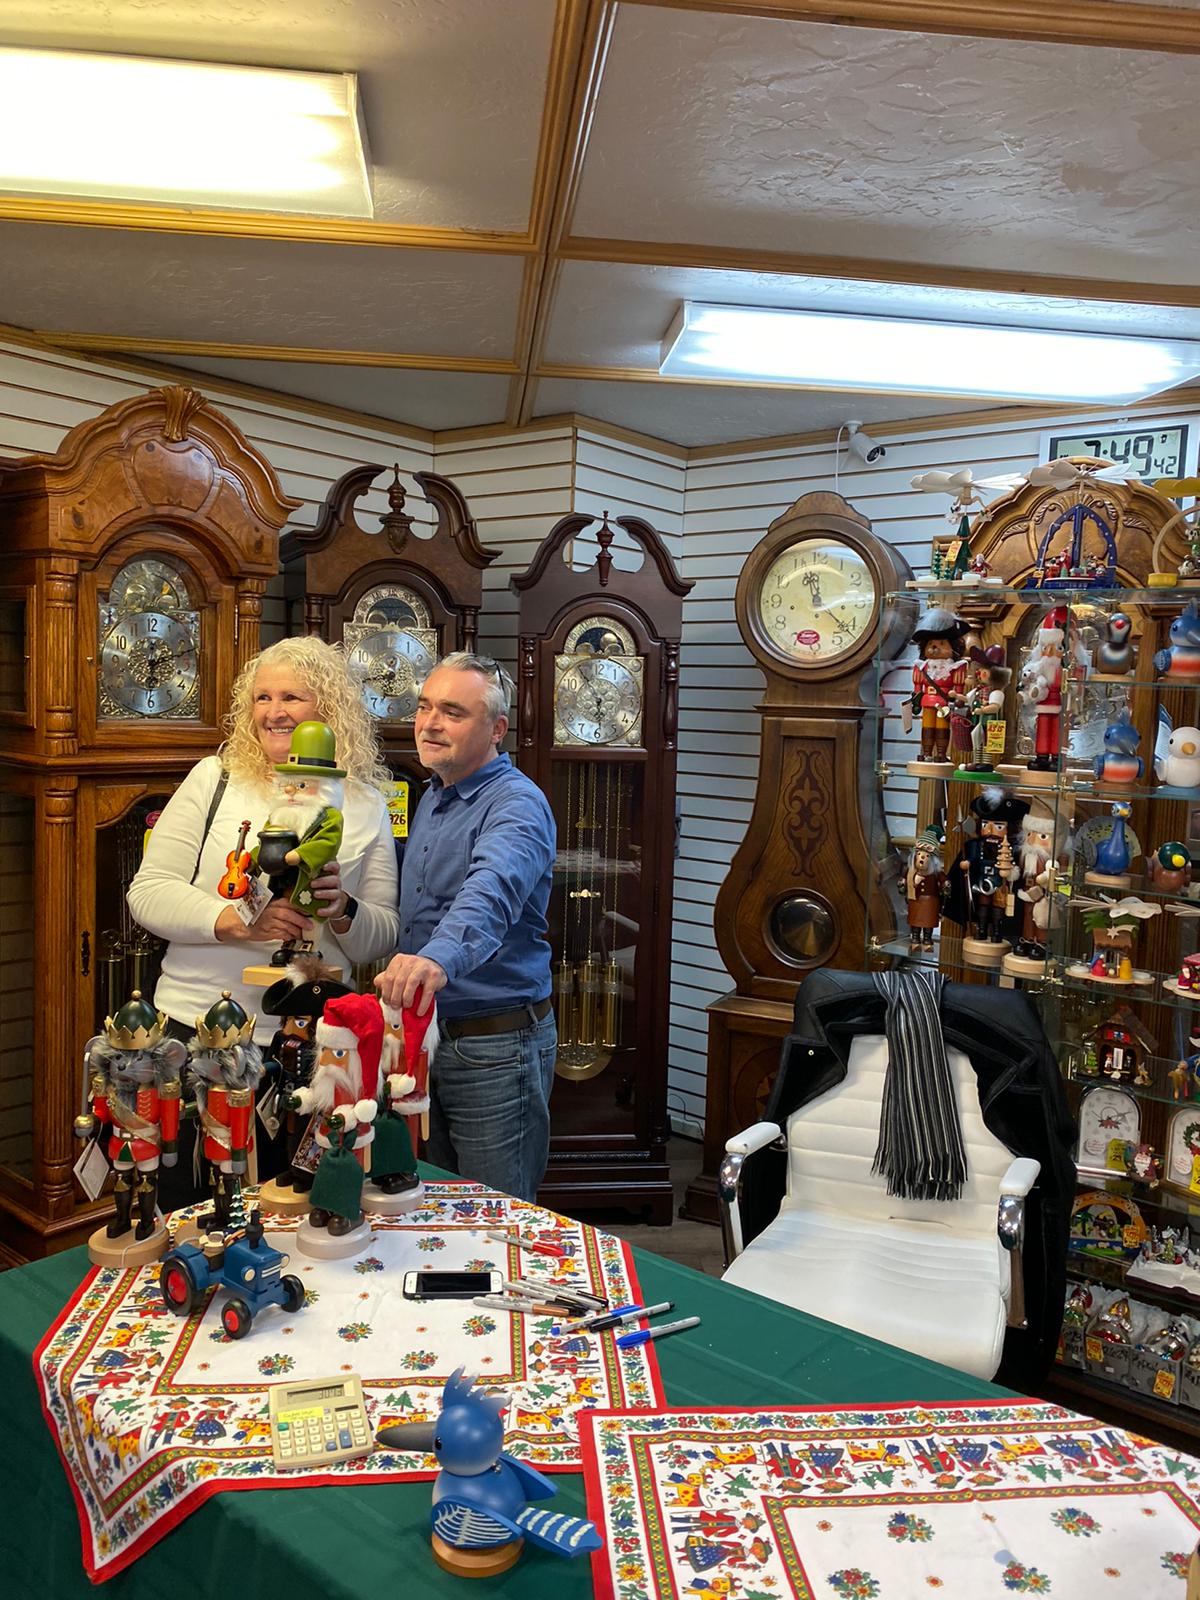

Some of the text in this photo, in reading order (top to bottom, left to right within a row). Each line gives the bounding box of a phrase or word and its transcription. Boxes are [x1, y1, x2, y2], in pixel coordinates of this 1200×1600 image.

[1154, 456, 1177, 474] 42
[812, 551, 829, 565] 12
[850, 572, 862, 587] 2
[771, 593, 782, 609] 9
[147, 618, 158, 632] 12
[775, 614, 786, 630] 8
[116, 635, 127, 650] 10
[832, 630, 843, 646] 5
[358, 650, 369, 664] 10
[594, 663, 605, 676] 12
[176, 679, 186, 691] 4
[567, 678, 578, 691] 10
[147, 693, 155, 709] 6
[166, 689, 173, 703] 5
[370, 697, 378, 710] 7
[387, 703, 394, 715] 6
[567, 710, 575, 723] 8
[578, 722, 585, 735] 7
[594, 728, 601, 739] 6
[611, 723, 617, 736] 5
